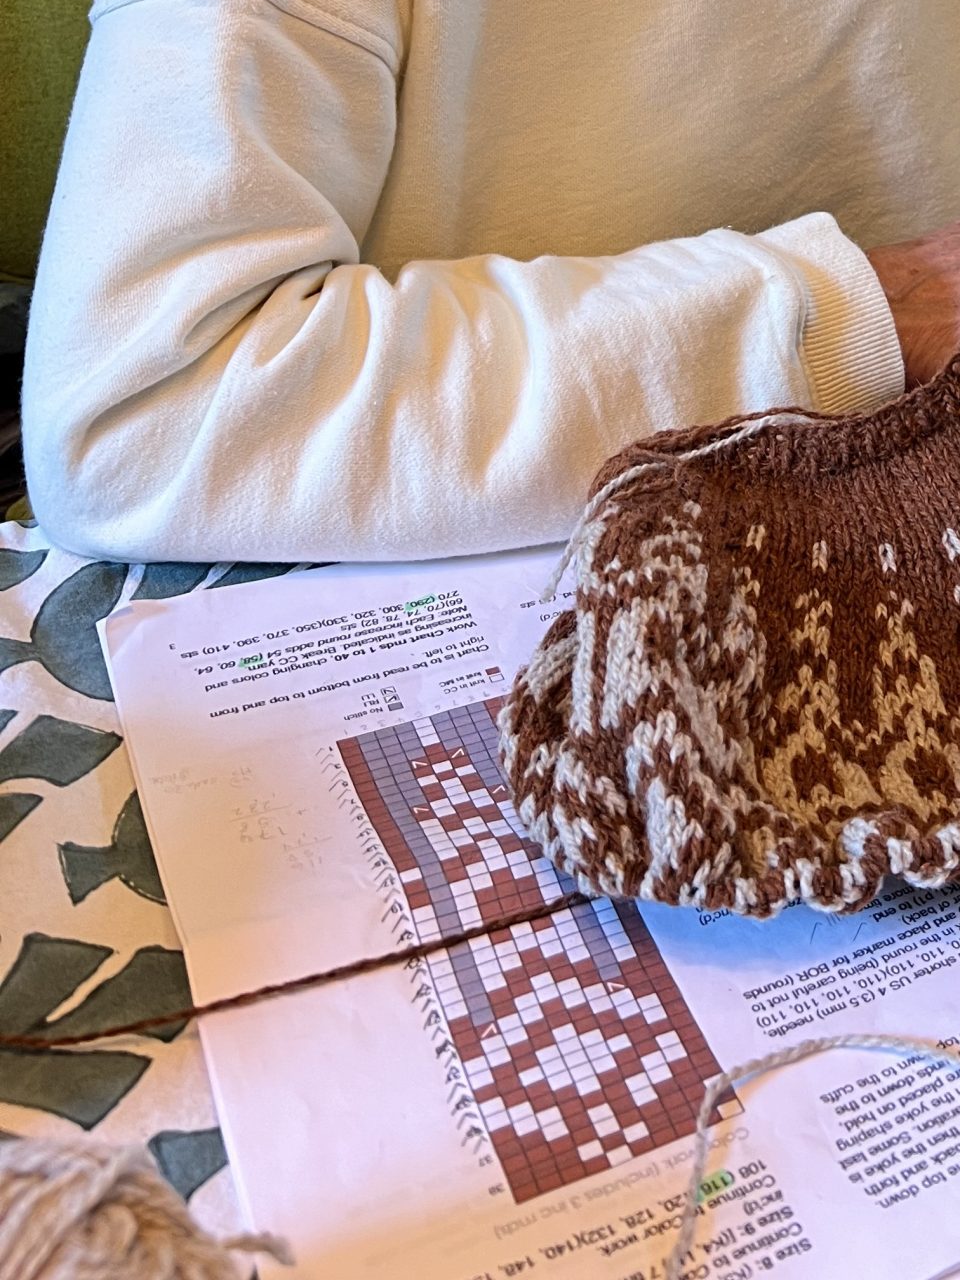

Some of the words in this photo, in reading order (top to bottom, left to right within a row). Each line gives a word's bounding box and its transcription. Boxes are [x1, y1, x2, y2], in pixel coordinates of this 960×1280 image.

[437, 589, 460, 601] 270
[350, 609, 377, 620] 320,
[378, 604, 405, 614] 300,
[340, 622, 357, 632] sts
[360, 618, 379, 628] 82)
[405, 613, 435, 626] Each
[414, 612, 473, 632] increasing
[445, 620, 478, 633] Work
[262, 629, 290, 640] 370,
[354, 621, 403, 638] increase
[397, 628, 412, 637] as
[409, 629, 445, 643] Chart
[232, 636, 261, 648] 390,
[284, 641, 315, 654] adds
[317, 633, 352, 648] round
[459, 635, 485, 648] right
[180, 650, 199, 659] sts
[202, 644, 231, 656] 410)
[266, 649, 282, 659] 54
[300, 646, 337, 660] Break
[330, 653, 350, 662] 40,
[456, 644, 490, 658] Chart
[217, 660, 236, 670] 60,
[271, 657, 328, 676] changing
[278, 655, 299, 666] CC
[411, 661, 429, 670] be
[231, 671, 270, 684] colors
[352, 672, 381, 684] from
[382, 665, 410, 678] read
[204, 680, 229, 693] and
[307, 680, 351, 696] bottom
[242, 700, 266, 712] and
[269, 695, 290, 704] top
[209, 706, 240, 718] from
[897, 900, 914, 911] to
[937, 900, 951, 912] of
[868, 906, 898, 923] end.
[932, 911, 957, 928] and
[896, 920, 932, 941] place
[940, 926, 957, 937] in
[919, 933, 942, 946] the
[852, 936, 896, 960] marker
[880, 942, 919, 964] round
[915, 946, 945, 963] 110,
[831, 954, 851, 968] for
[837, 956, 880, 980] (being
[913, 955, 957, 980] shorter
[795, 962, 831, 982] BOR
[742, 974, 795, 1000] (rounds
[791, 975, 837, 1000] careful
[888, 975, 913, 991] US
[820, 985, 851, 1002] 110,
[849, 989, 876, 1008] (3.5
[877, 987, 887, 996] 4
[751, 1001, 767, 1013] to
[766, 992, 790, 1008] not
[788, 997, 819, 1014] 110,
[816, 1001, 848, 1020] mm)
[755, 1010, 787, 1029] 110)
[763, 1014, 815, 1038] needle,
[880, 1066, 898, 1078] to
[855, 1073, 882, 1088] the
[876, 1074, 916, 1098] down
[819, 1084, 855, 1104] cuffs
[860, 1092, 878, 1105] to
[897, 1076, 945, 1108] placed
[930, 1091, 956, 1108] the
[834, 1099, 861, 1116] the
[876, 1102, 897, 1116] on
[894, 1101, 931, 1125] yoke
[835, 1120, 894, 1152] shaping
[926, 1126, 960, 1147] then
[867, 1131, 913, 1157] Some
[901, 1142, 928, 1159] the
[837, 1151, 869, 1171] last
[864, 1151, 902, 1177] yoke
[737, 1159, 767, 1180] 108
[899, 1160, 929, 1182] and
[847, 1171, 865, 1184] is
[863, 1174, 900, 1196] forth
[921, 1171, 948, 1189] top
[706, 1174, 776, 1210] Continue
[643, 1213, 687, 1239] Color
[731, 1221, 803, 1260] Continue
[712, 1254, 732, 1269] to
